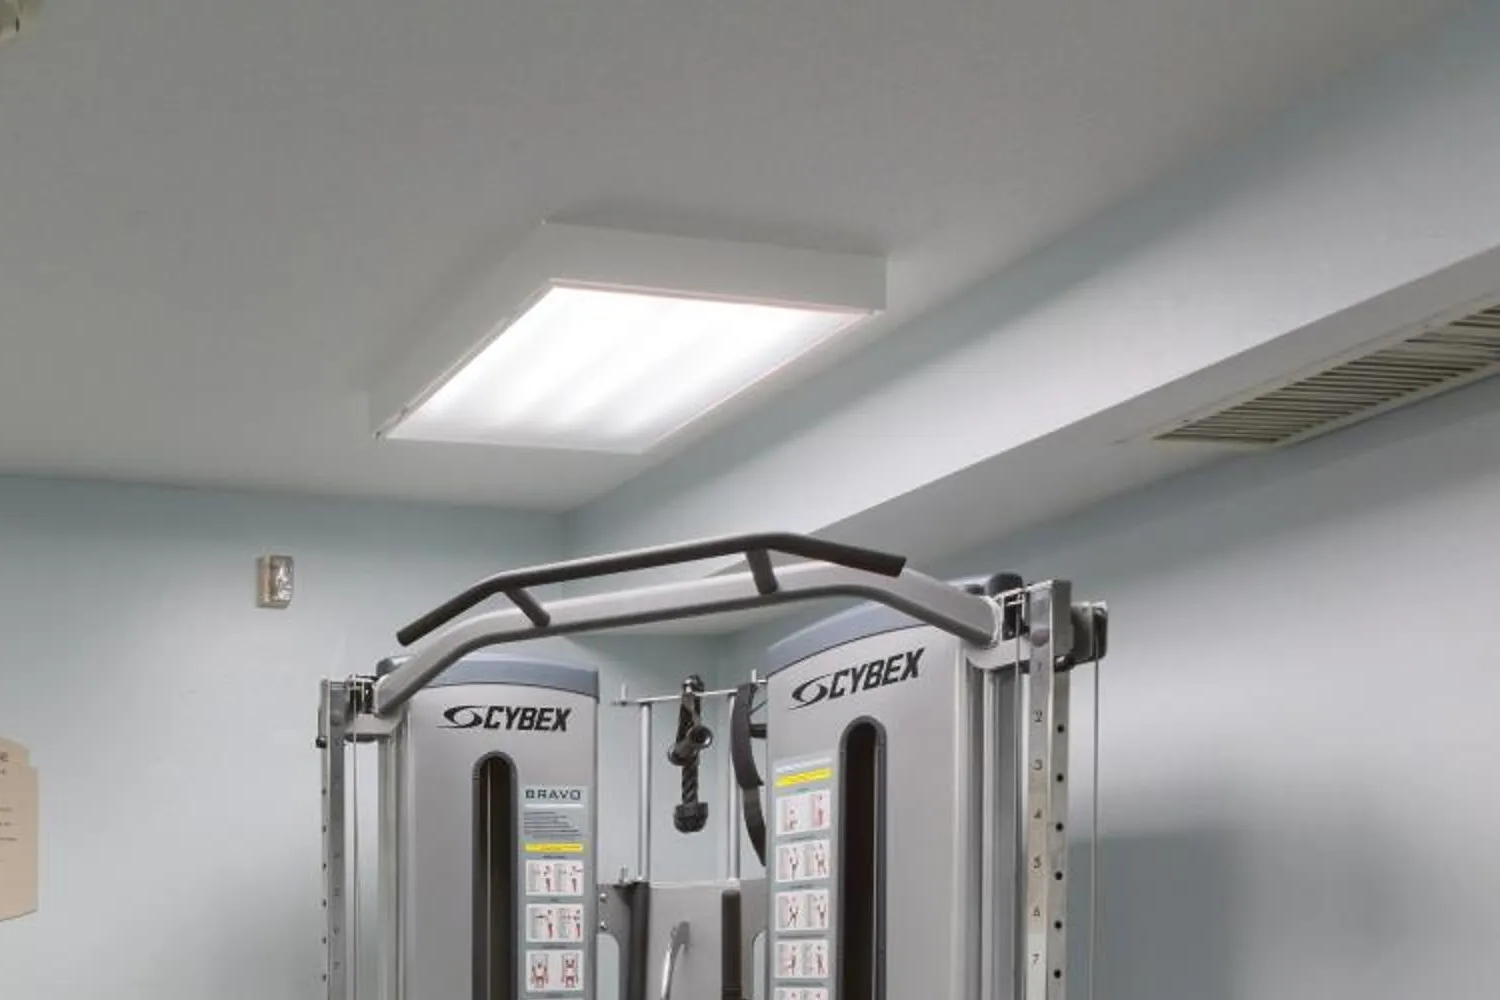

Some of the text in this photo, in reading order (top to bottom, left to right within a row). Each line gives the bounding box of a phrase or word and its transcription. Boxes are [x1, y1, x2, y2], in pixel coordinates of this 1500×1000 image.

[828, 648, 925, 700] CYBEX
[483, 706, 572, 732] CYBEX
[525, 789, 581, 800] BRAVO
